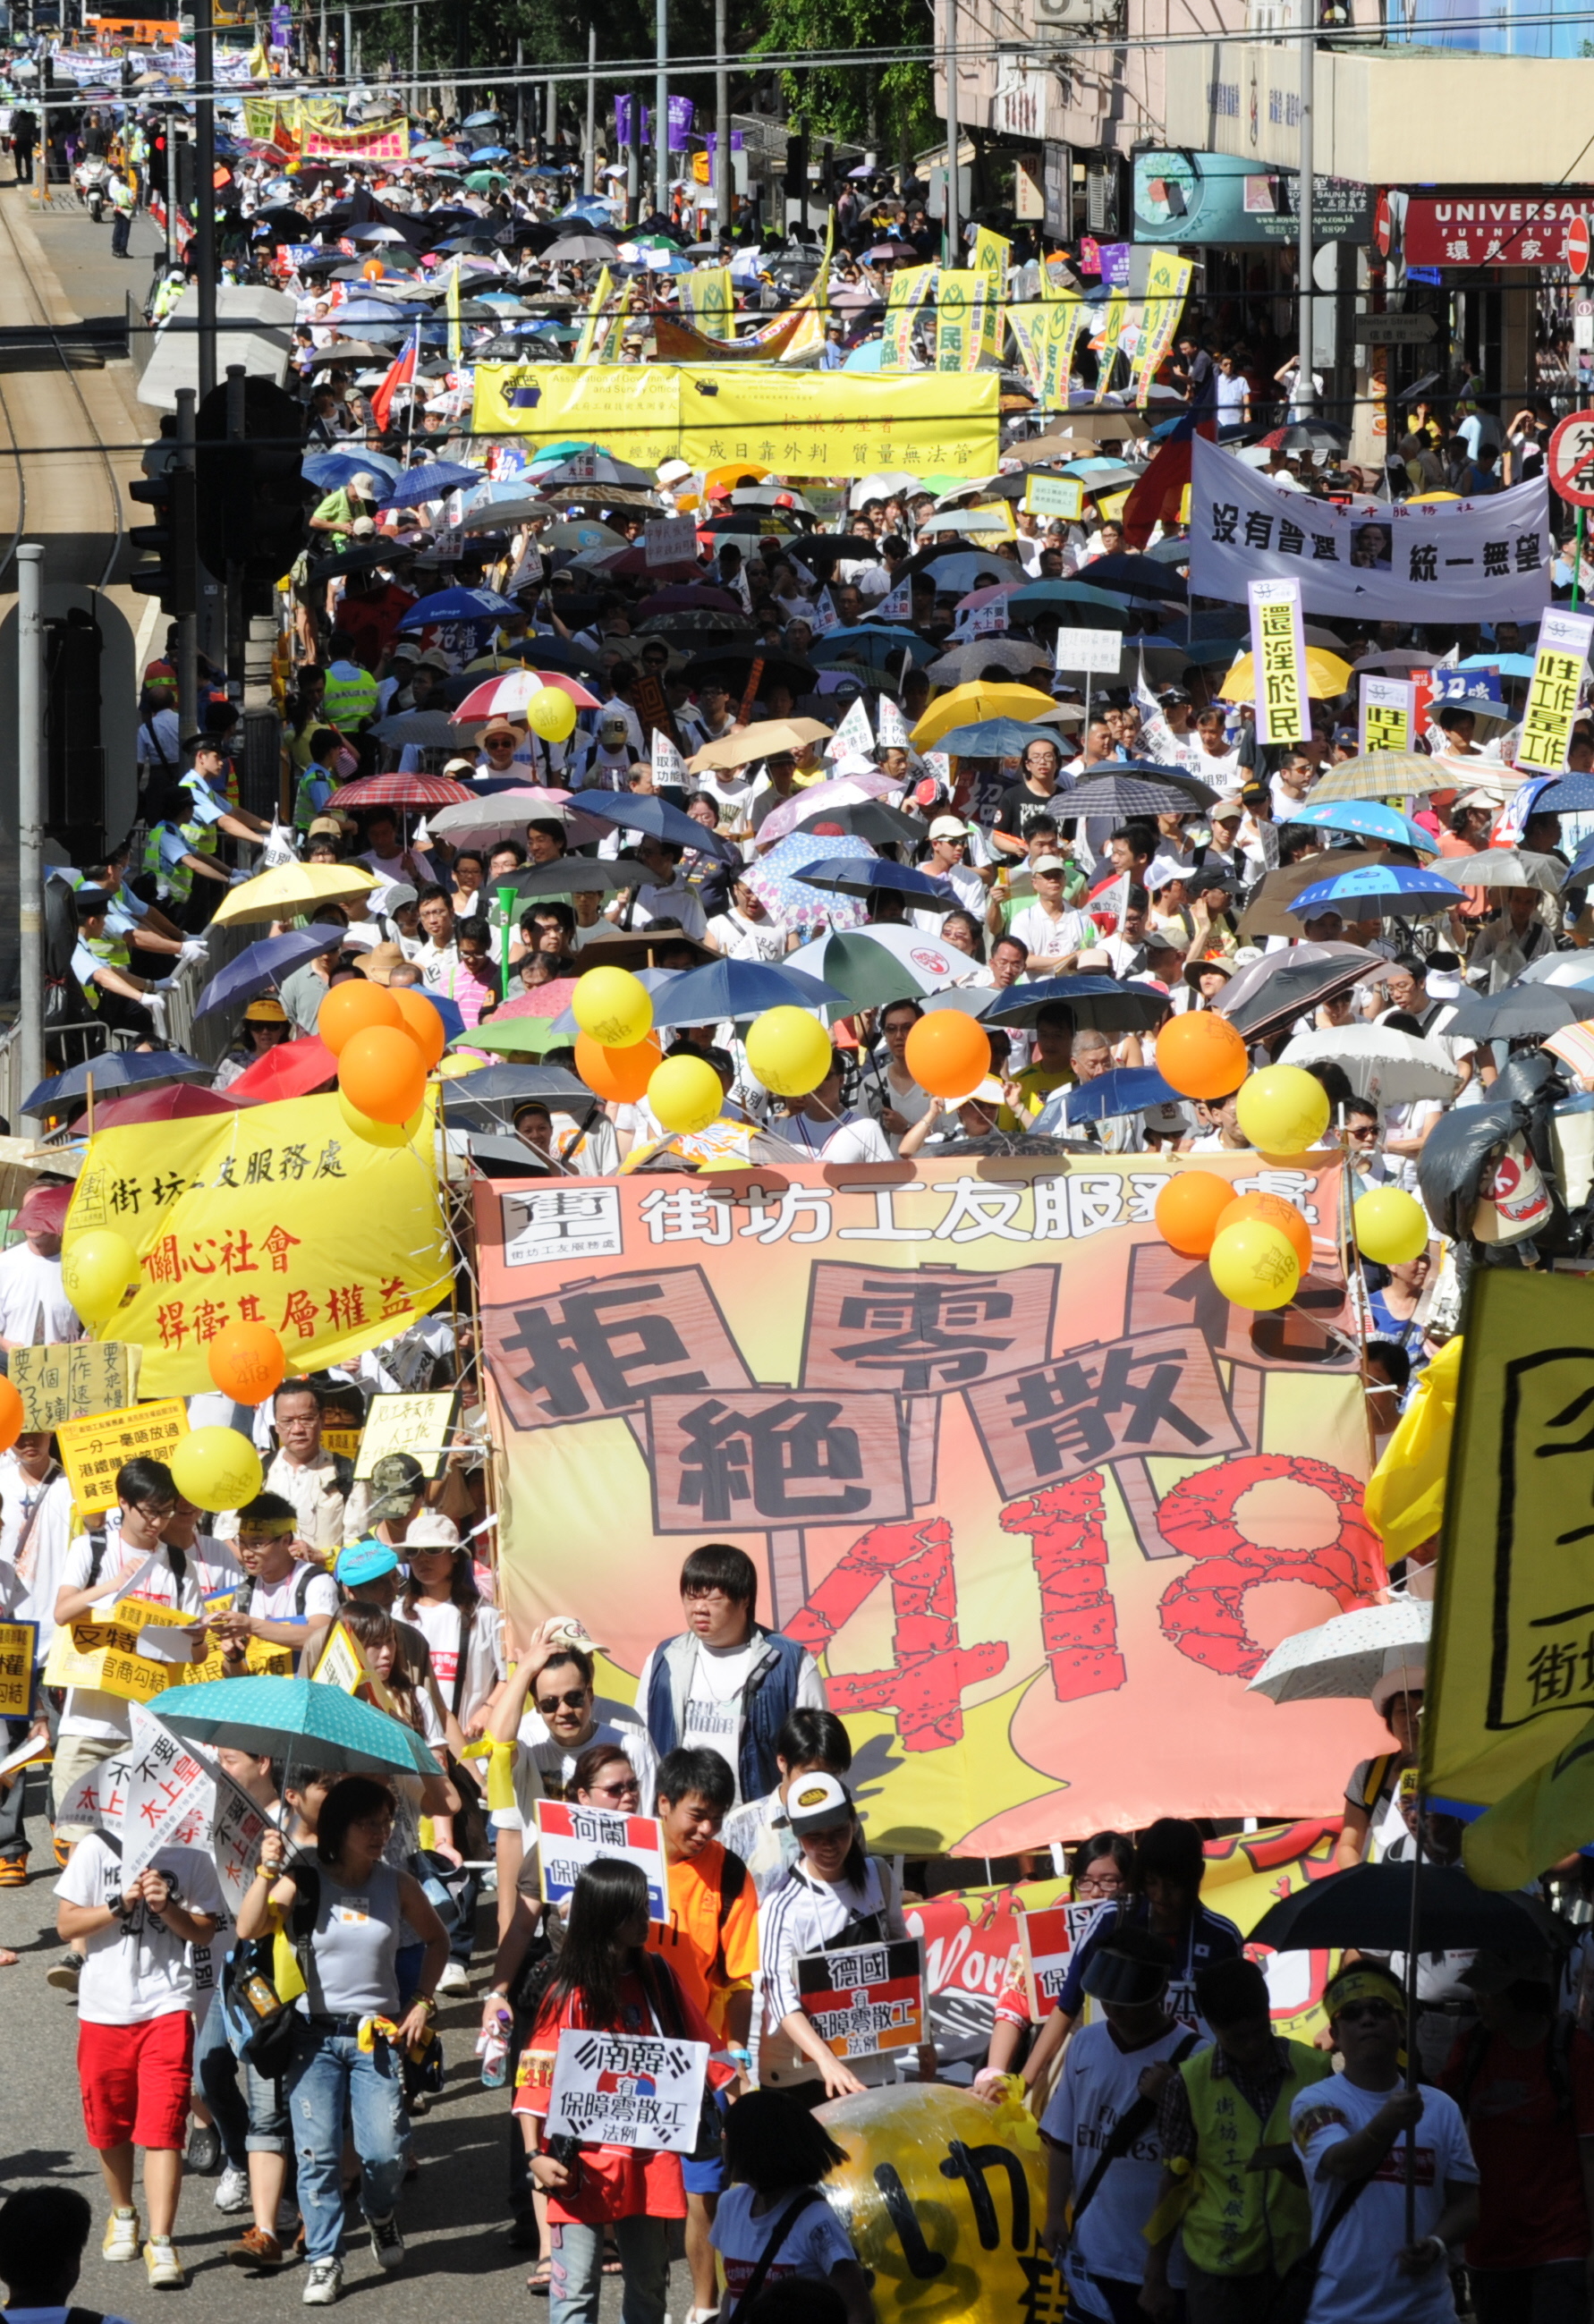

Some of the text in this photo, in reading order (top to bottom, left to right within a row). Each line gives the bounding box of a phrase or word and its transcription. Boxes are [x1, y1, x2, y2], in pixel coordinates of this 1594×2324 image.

[1442, 227, 1570, 237] FURNITUR
[1391, 317, 1418, 326] Street
[615, 386, 647, 395] Survy
[622, 373, 680, 384] Govrnment
[782, 412, 896, 433] 抗議房屋署
[708, 439, 973, 465] 成日靠外判 質量無法管
[1210, 502, 1542, 582] 沒有普選 統一無望
[1262, 605, 1301, 739] 還淫於民
[656, 756, 681, 768] 取消
[141, 1225, 301, 1285] 關心社會
[509, 1238, 617, 1260] 街坊工友服務處
[1274, 1255, 1296, 1289] 418
[236, 1365, 270, 1386] 418
[74, 1421, 181, 1455] 一分一毫唔放過
[780, 1453, 1389, 1752] 418
[135, 1733, 180, 1783] 不要
[140, 1753, 204, 1829] 太上皇
[568, 1809, 626, 1847] 荷蘭
[225, 1812, 264, 1887] 太上皇
[827, 1948, 890, 1991] 德國
[852, 1990, 869, 2008] 有
[810, 1997, 916, 2041] 保障零散工
[596, 2037, 666, 2076] 南韓
[848, 2031, 879, 2055] 法例
[617, 2078, 637, 2100] 有
[560, 2091, 687, 2127] 保障零散工
[601, 2124, 638, 2143] 法例
